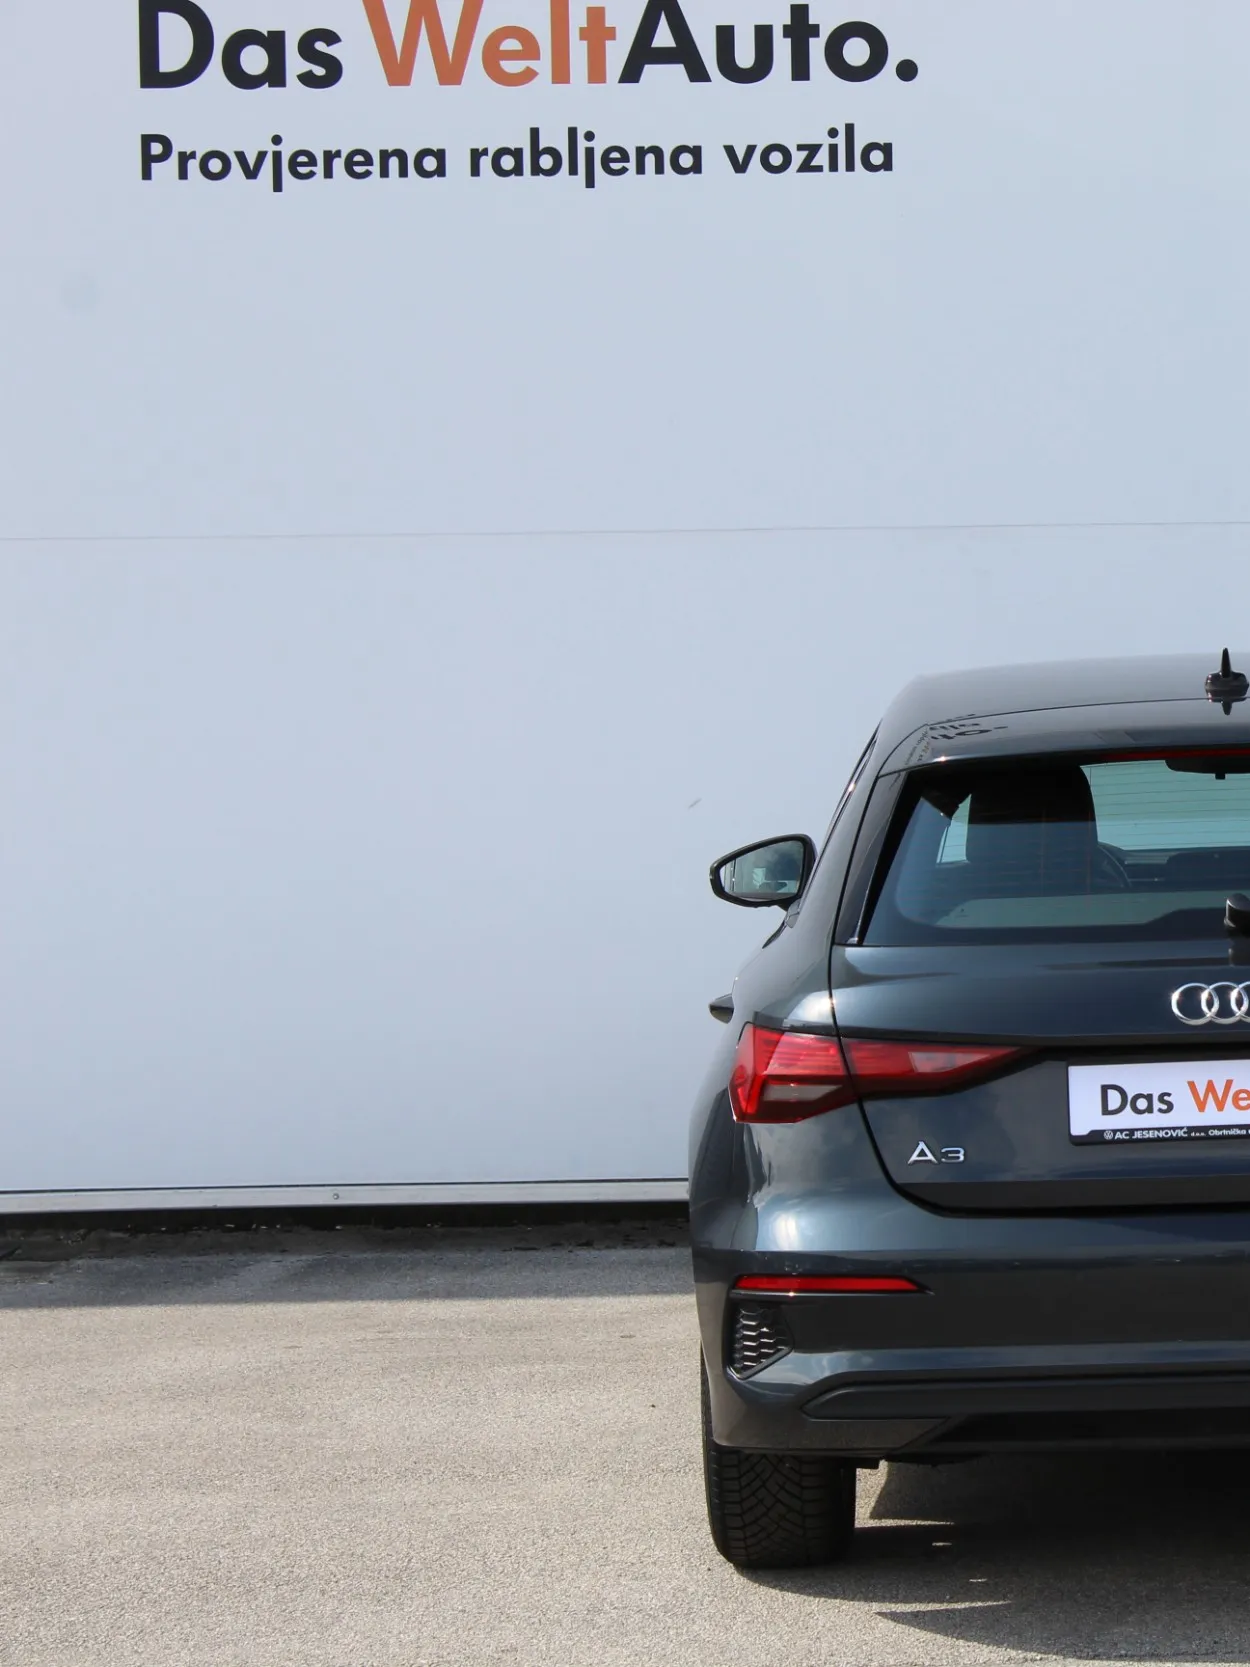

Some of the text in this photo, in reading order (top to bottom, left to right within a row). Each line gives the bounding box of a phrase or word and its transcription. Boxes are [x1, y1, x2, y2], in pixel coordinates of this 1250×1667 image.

[138, 0, 919, 91] Das WeltAuto.
[140, 123, 894, 193] Provjerena rabljena vozila
[1100, 1084, 1174, 1116] Das
[1114, 1131, 1130, 1140] AC
[1131, 1127, 1188, 1140] JESENOVIĆ
[1208, 1128, 1246, 1136] Obrtnička
[907, 1140, 965, 1165] A3
